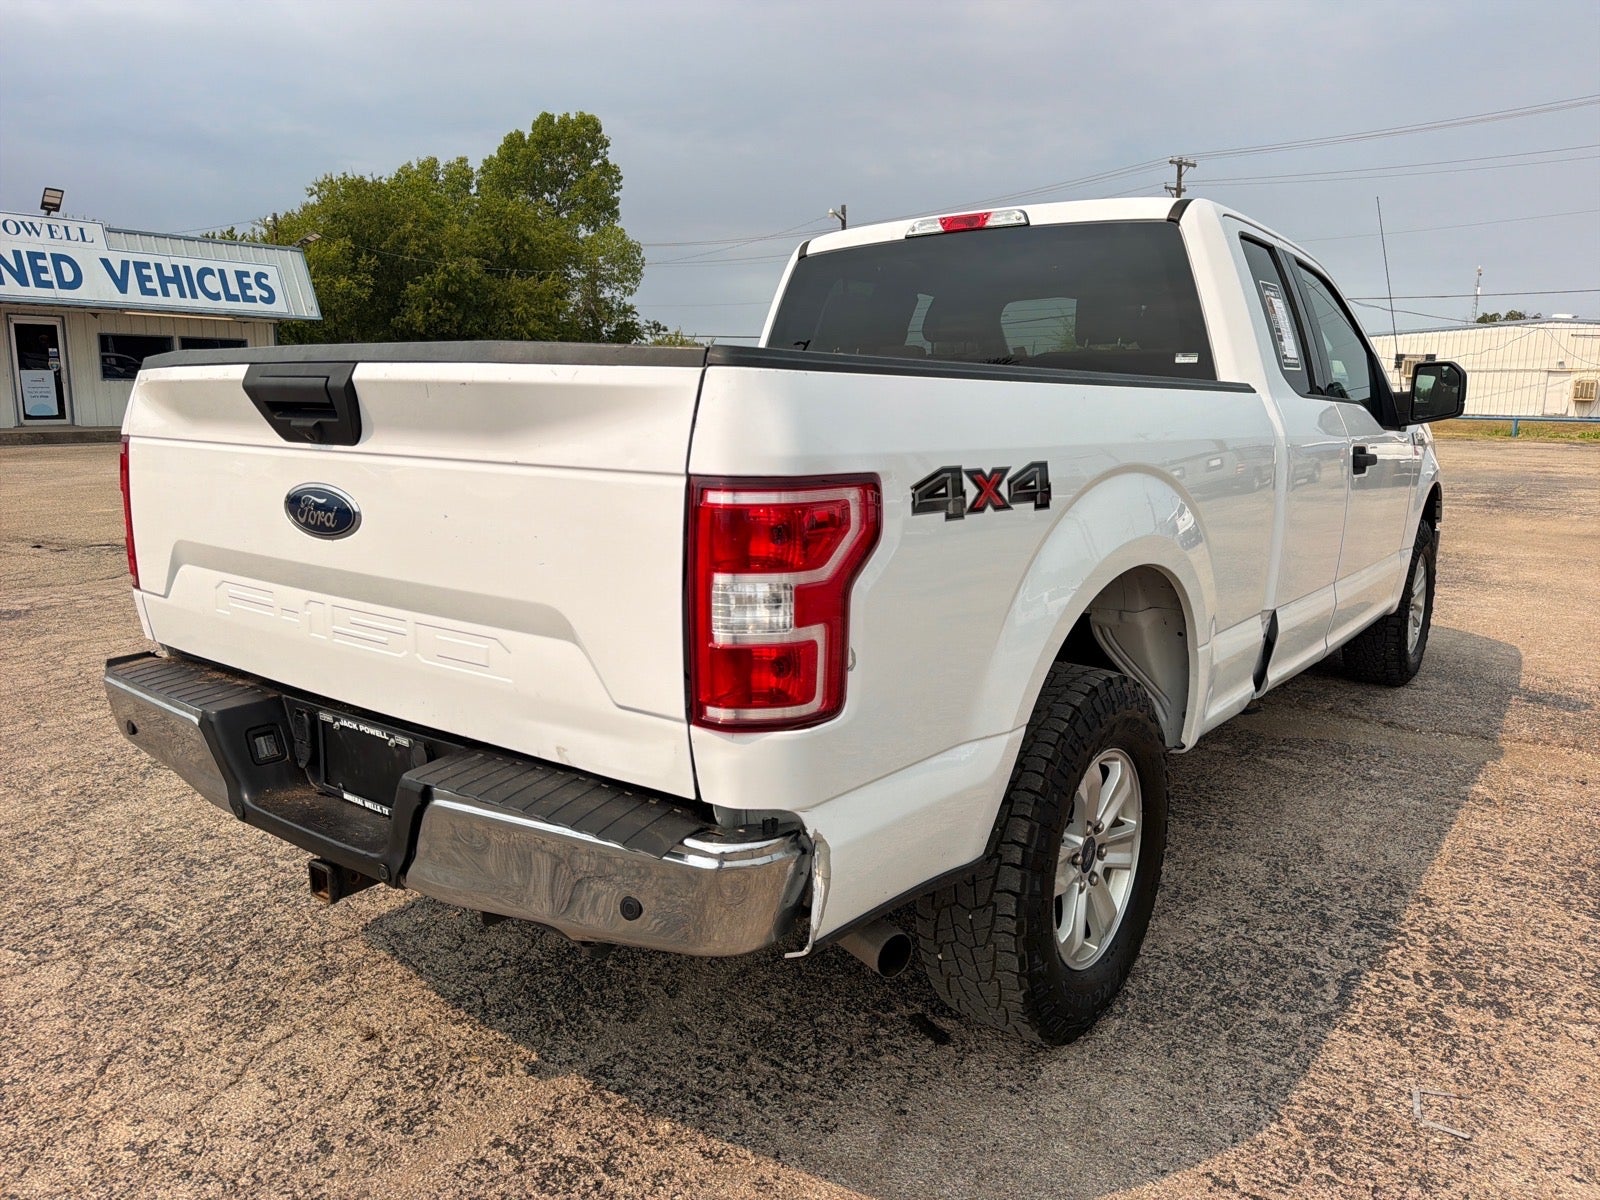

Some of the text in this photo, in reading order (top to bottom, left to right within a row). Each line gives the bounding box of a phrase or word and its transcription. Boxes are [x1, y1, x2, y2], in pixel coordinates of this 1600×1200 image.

[99, 257, 276, 305] VEHICLES
[297, 494, 338, 529] Ford
[215, 580, 513, 682] F-150
[339, 719, 389, 740] JACK POWELL
